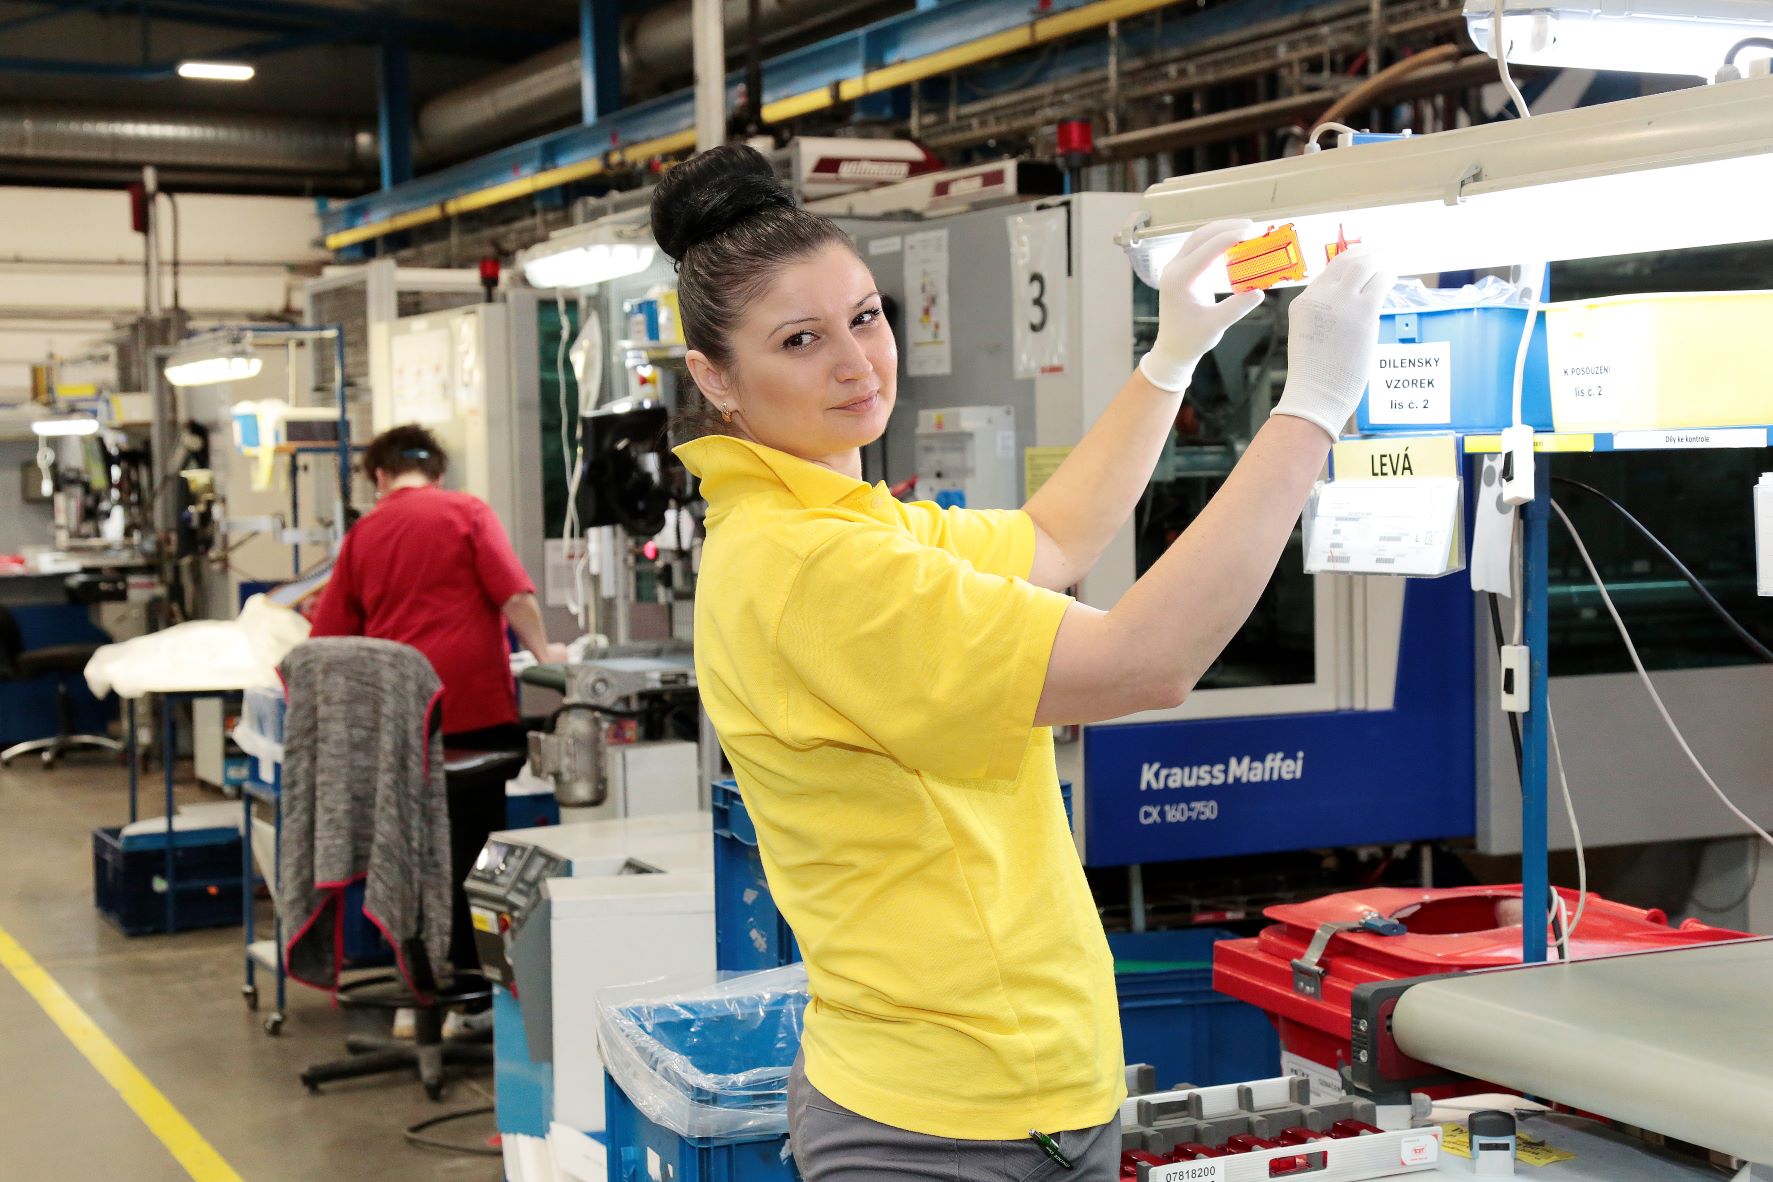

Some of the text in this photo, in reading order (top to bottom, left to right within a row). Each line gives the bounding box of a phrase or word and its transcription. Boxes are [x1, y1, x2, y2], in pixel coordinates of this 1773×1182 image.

[1029, 271, 1047, 333] 3
[1385, 378, 1435, 389] VZOREK
[1597, 385, 1603, 396] 2
[1390, 399, 1404, 410] lis
[1422, 398, 1429, 409] 2
[1371, 446, 1414, 477] LEVÁ
[1138, 800, 1218, 825] CX 160-750
[1165, 1165, 1216, 1182] 07818200
